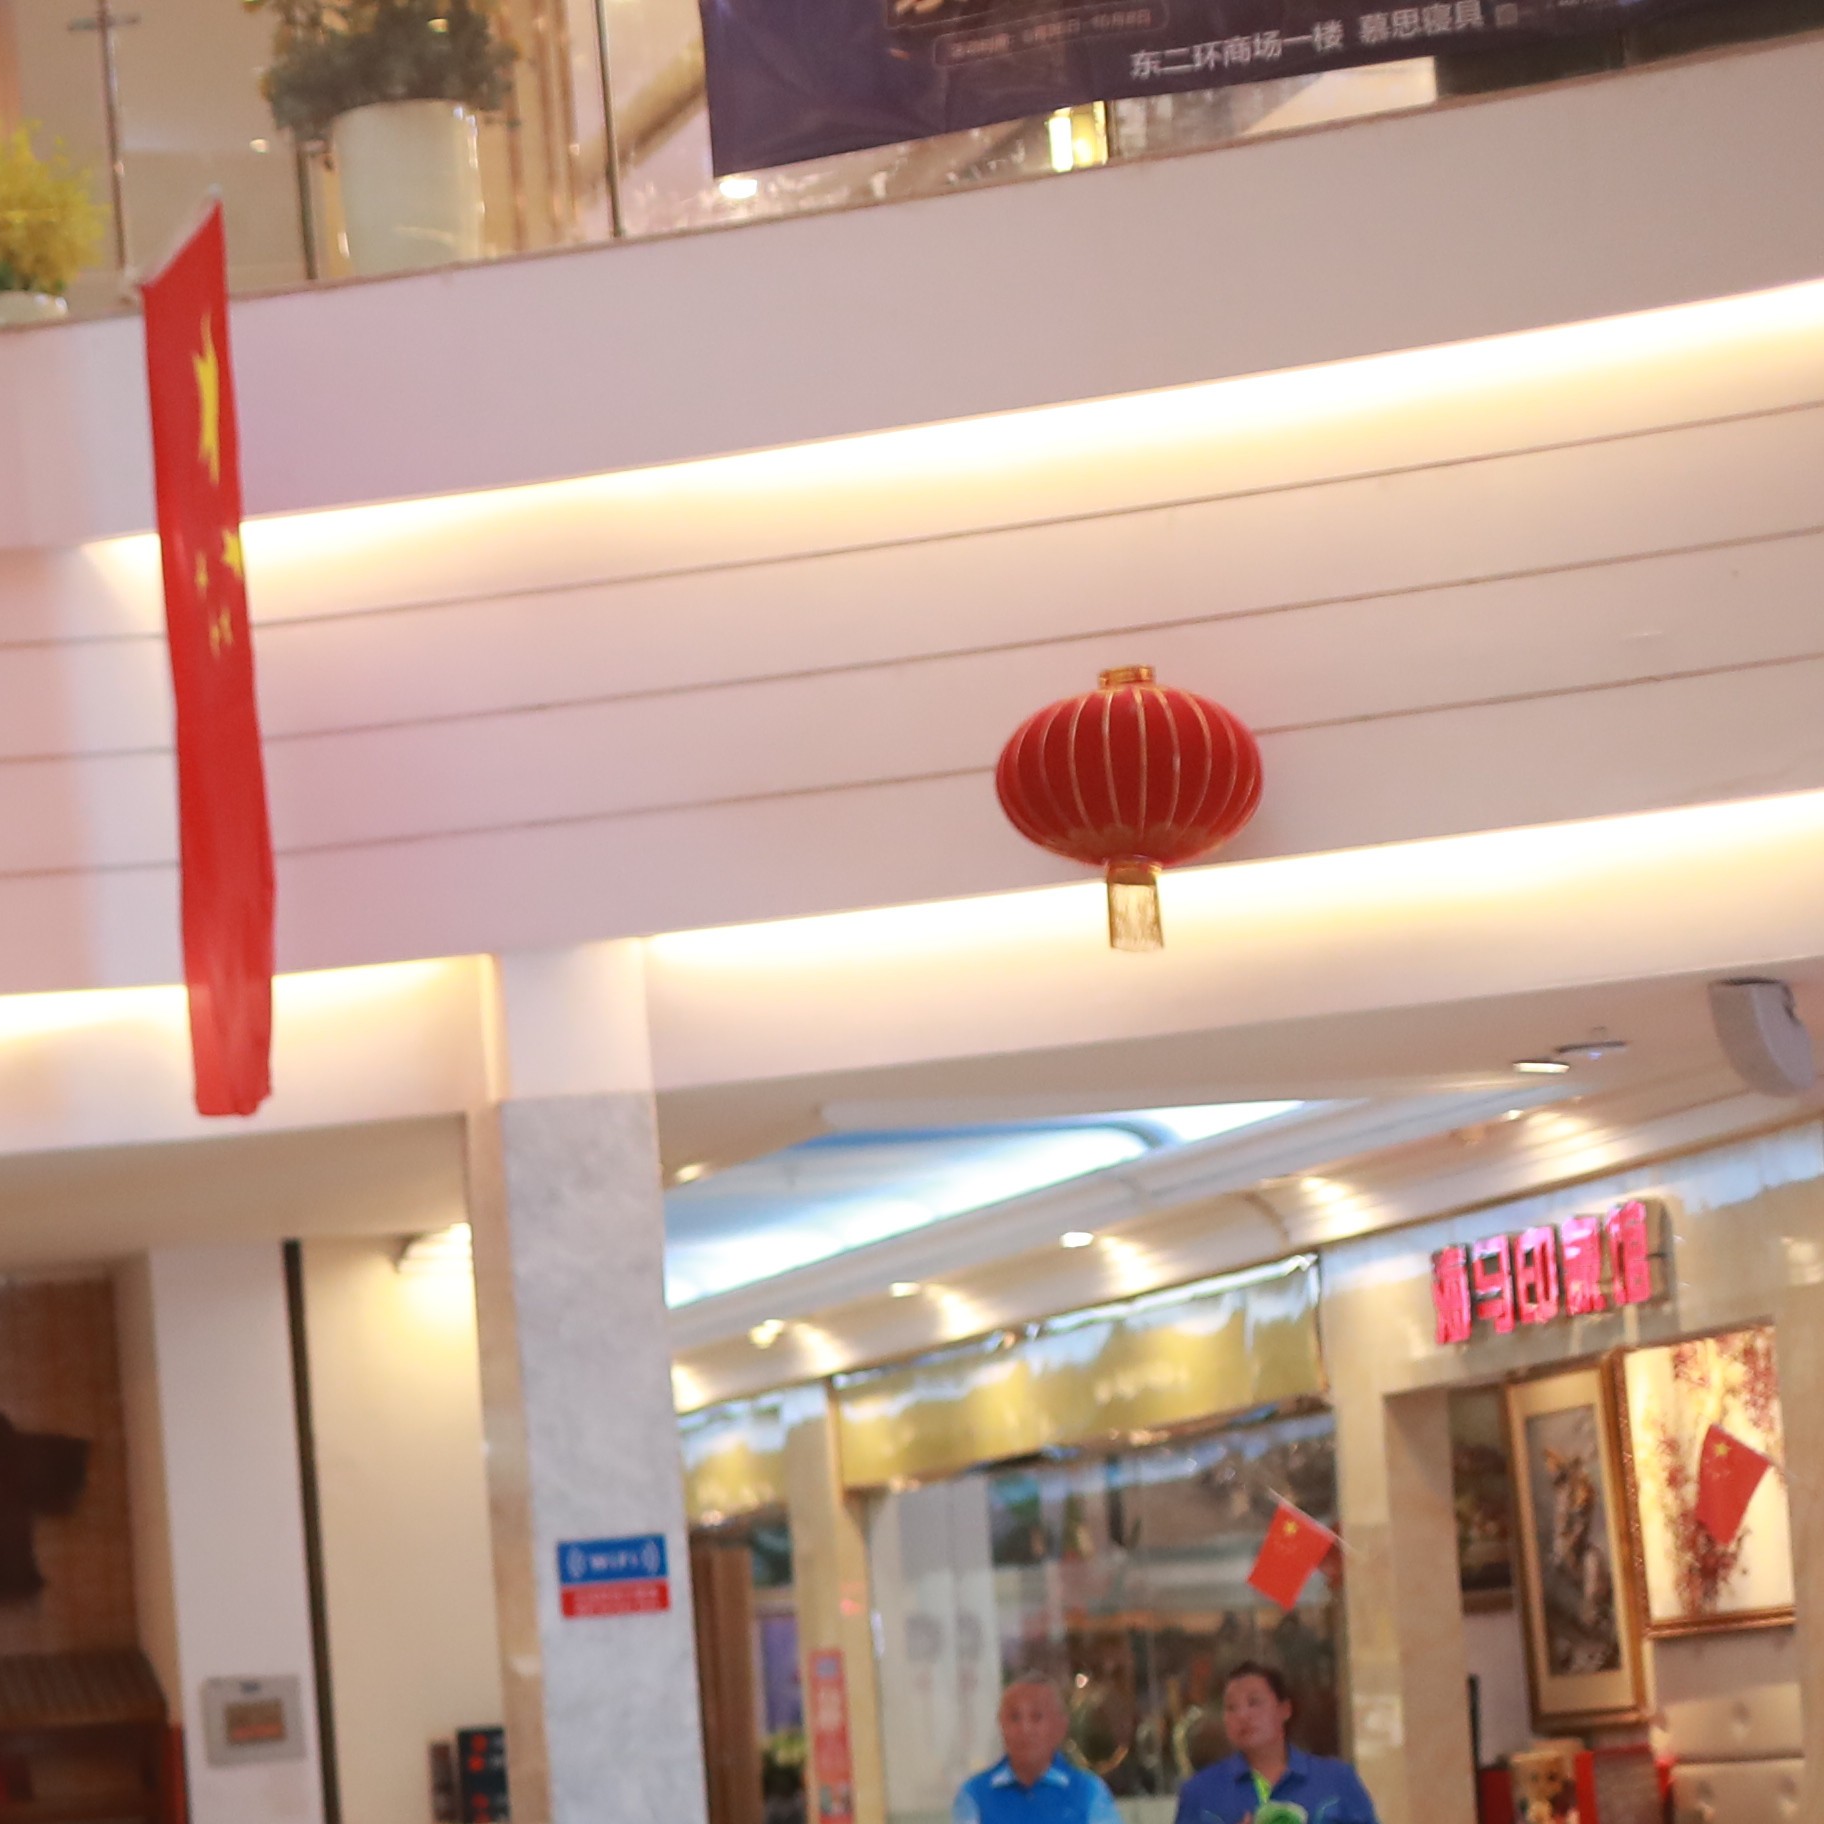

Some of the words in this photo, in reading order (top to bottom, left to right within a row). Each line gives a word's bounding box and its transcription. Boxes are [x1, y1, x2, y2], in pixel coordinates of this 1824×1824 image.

[1129, 20, 1346, 81] 东二环商场一楼
